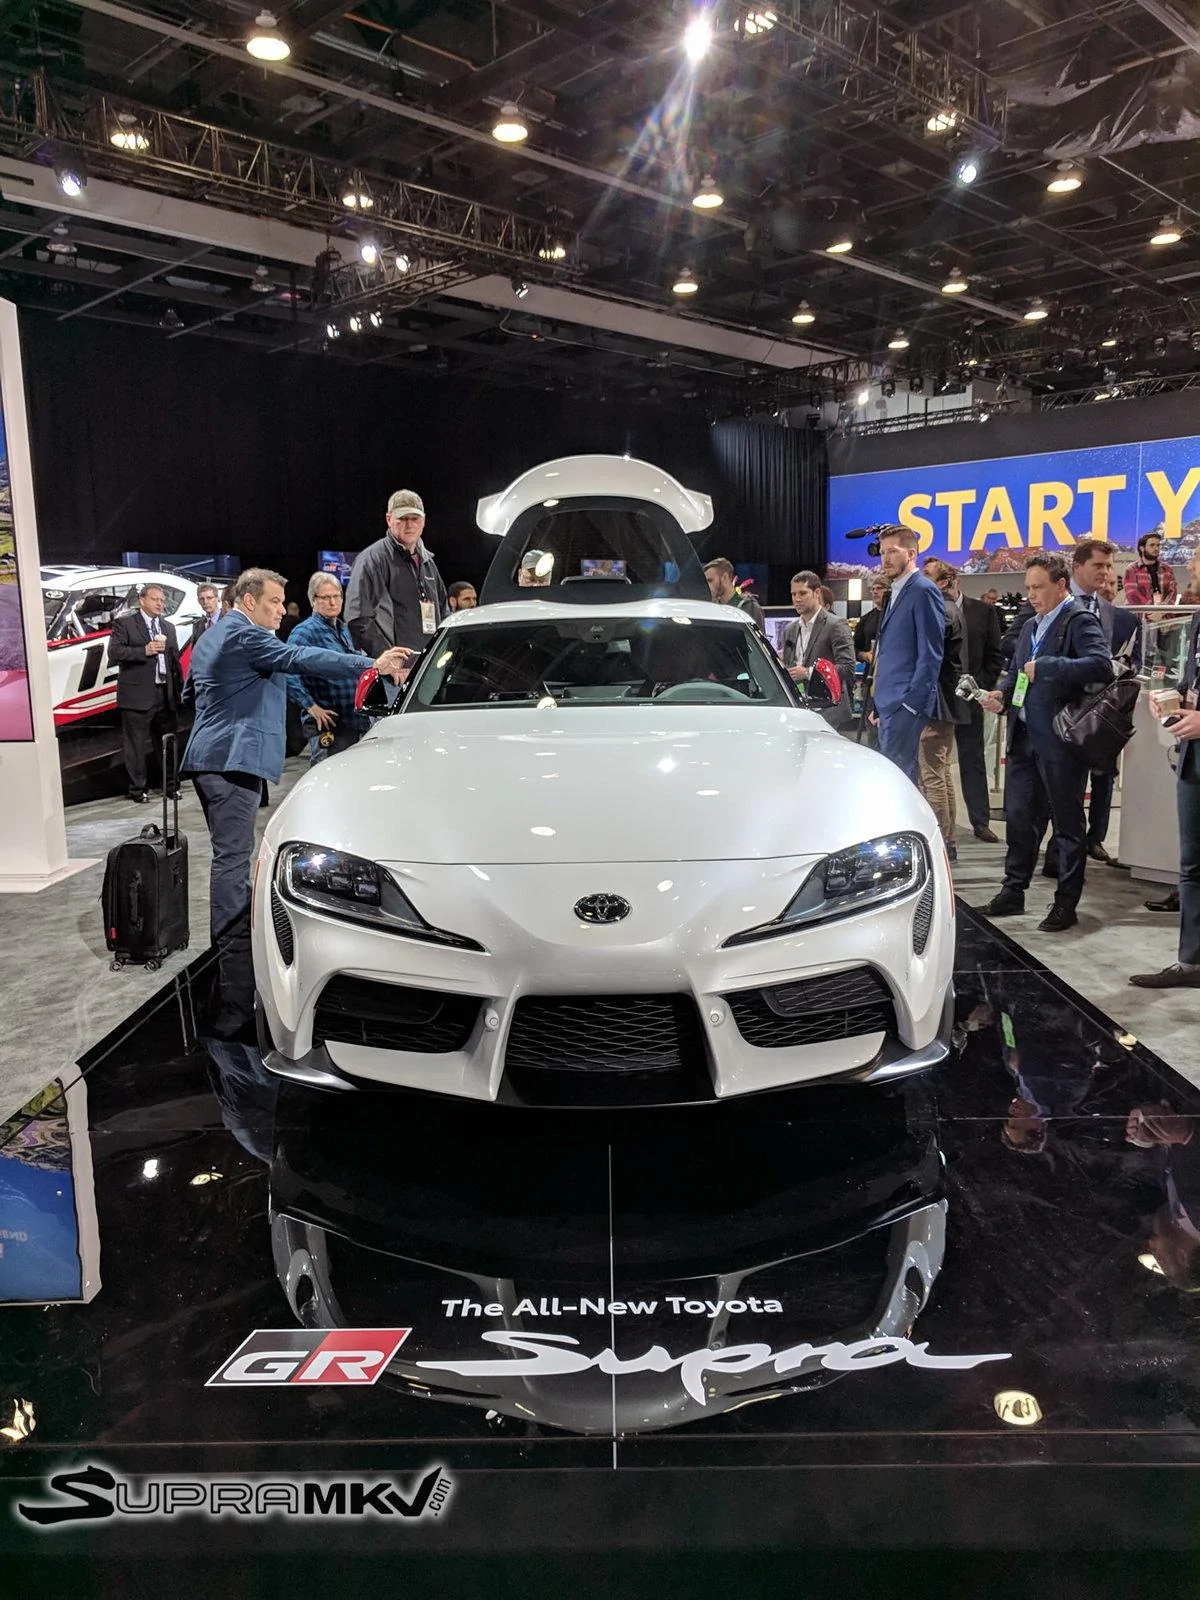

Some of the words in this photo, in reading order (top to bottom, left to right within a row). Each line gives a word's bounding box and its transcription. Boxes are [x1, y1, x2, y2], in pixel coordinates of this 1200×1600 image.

[898, 474, 1127, 554] START
[441, 1298, 504, 1317] The
[512, 1297, 658, 1316] All-New
[665, 1296, 784, 1318] Toyota
[222, 1350, 385, 1381] GR
[416, 1330, 1013, 1406] Supra
